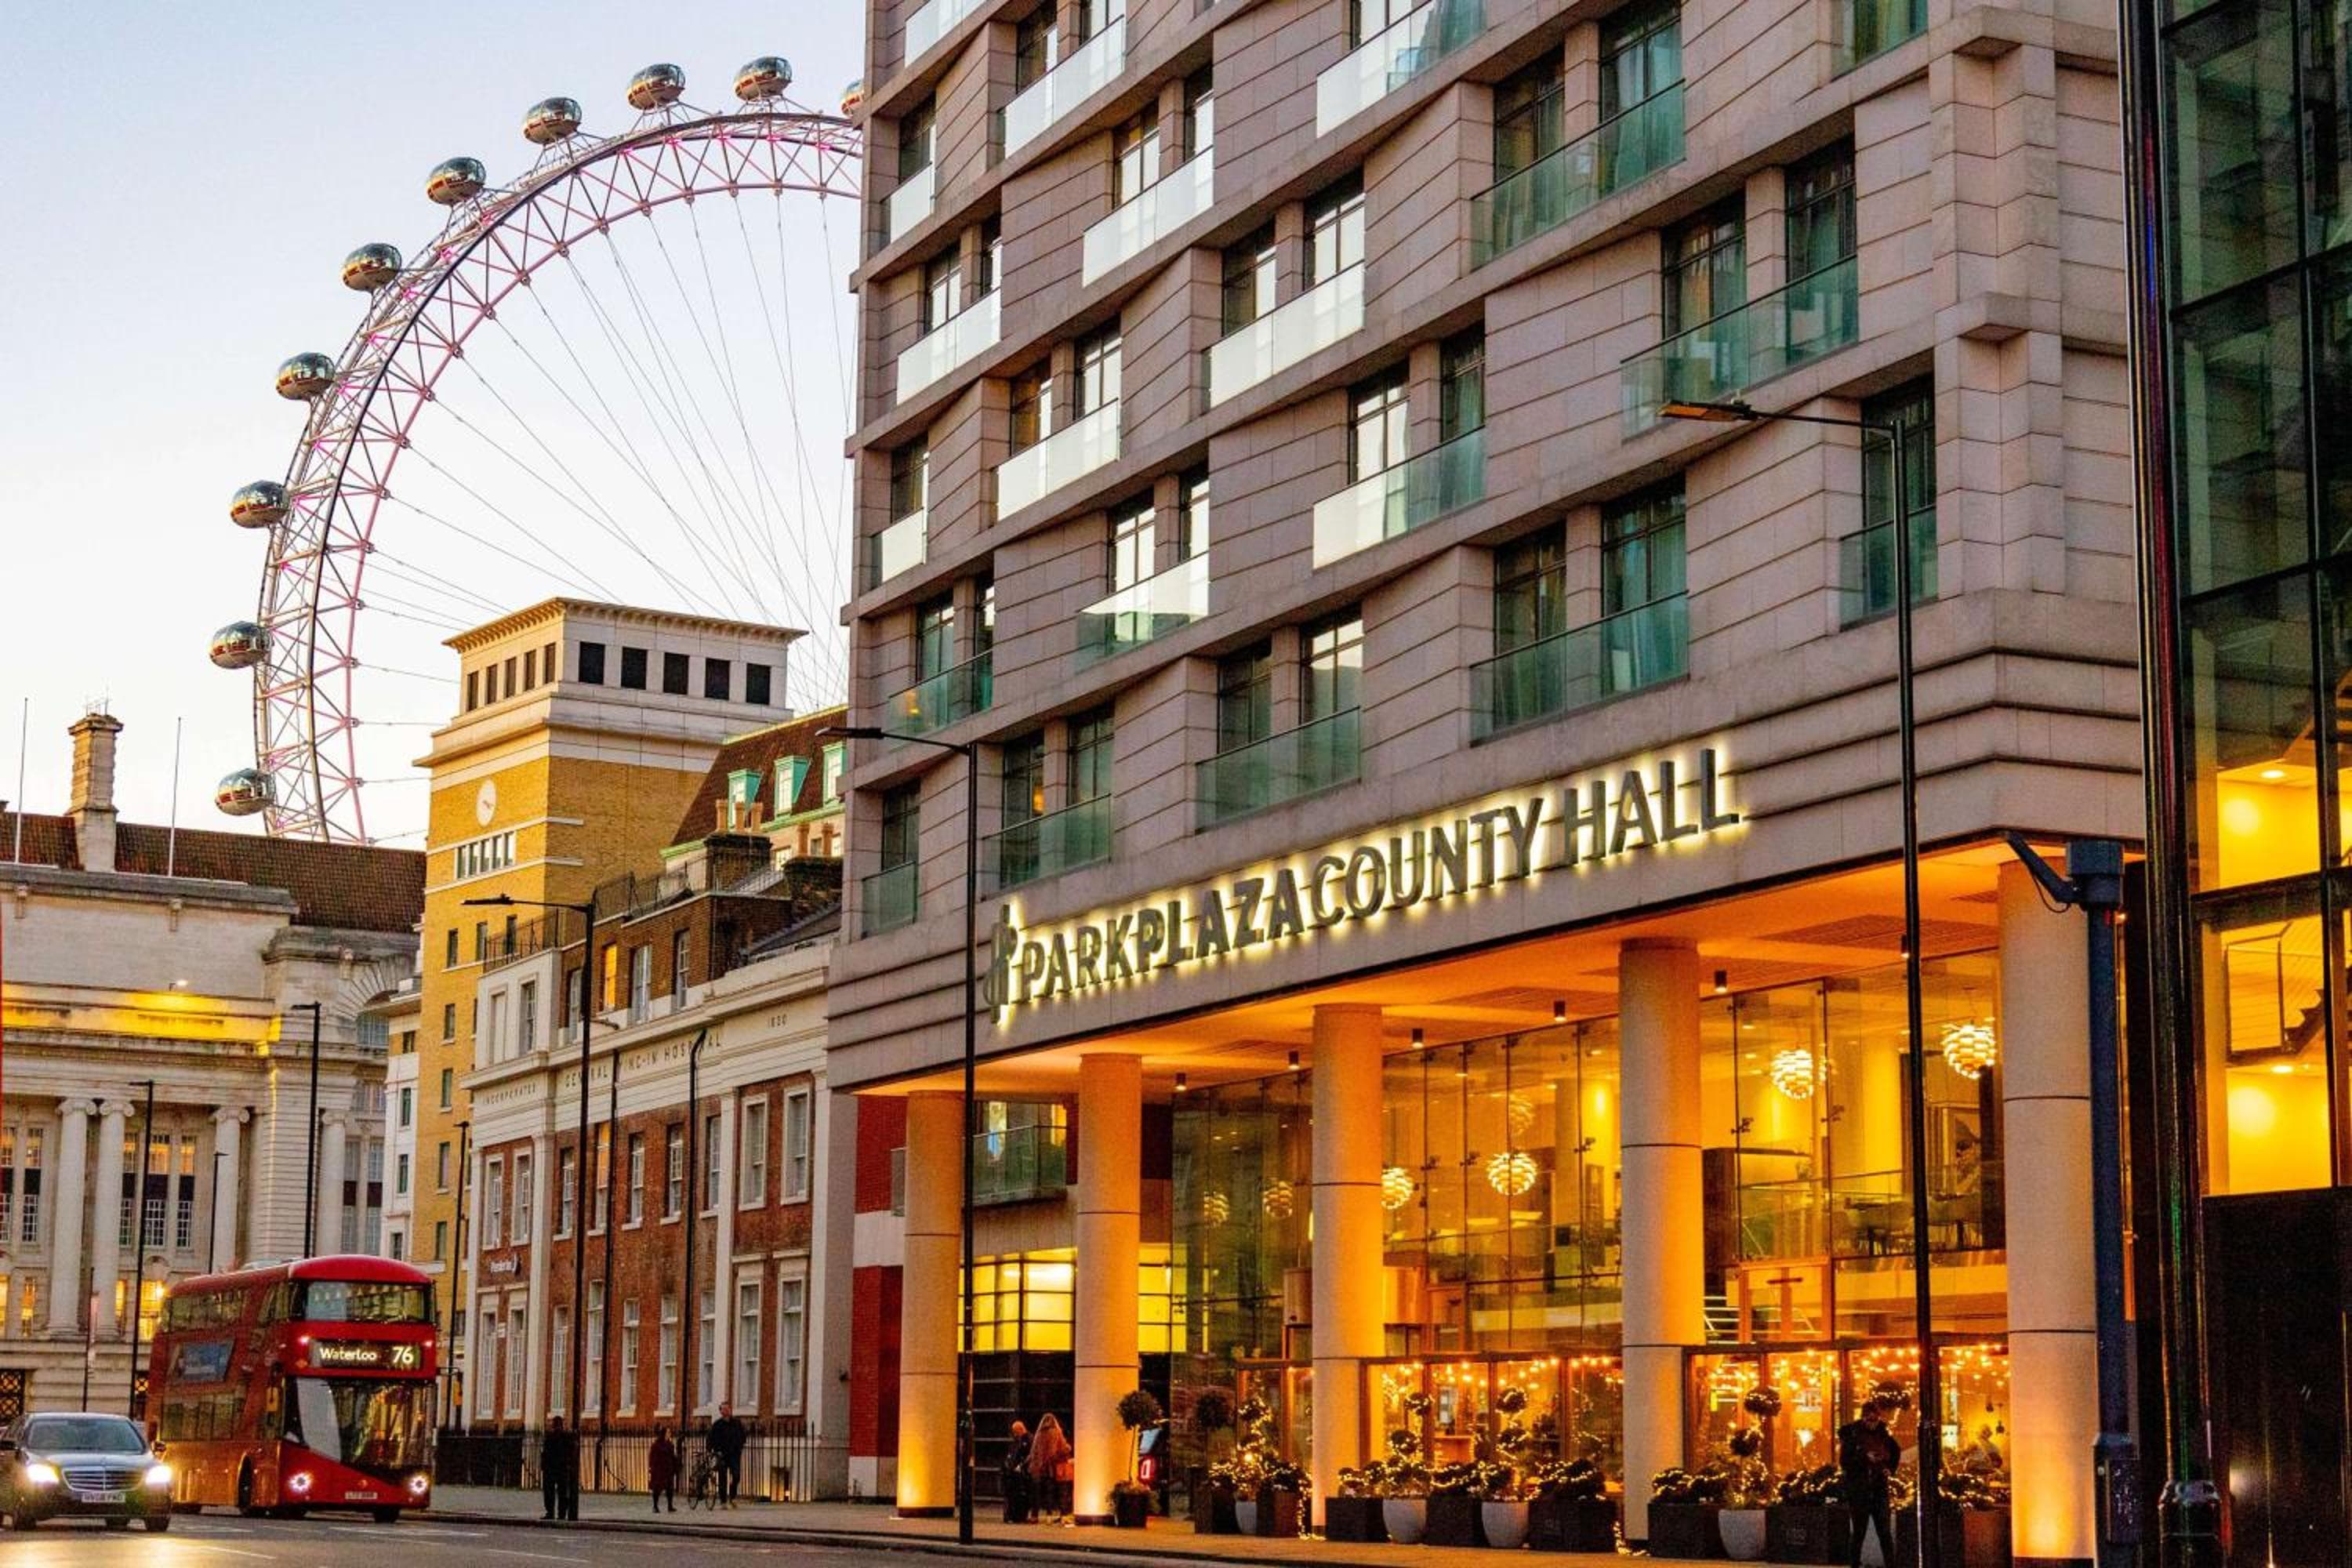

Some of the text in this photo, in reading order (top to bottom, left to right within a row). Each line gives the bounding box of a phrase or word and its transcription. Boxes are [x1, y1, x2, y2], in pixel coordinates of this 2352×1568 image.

[1565, 749, 1740, 865] HALL
[319, 1345, 414, 1364] Waterloo 76
